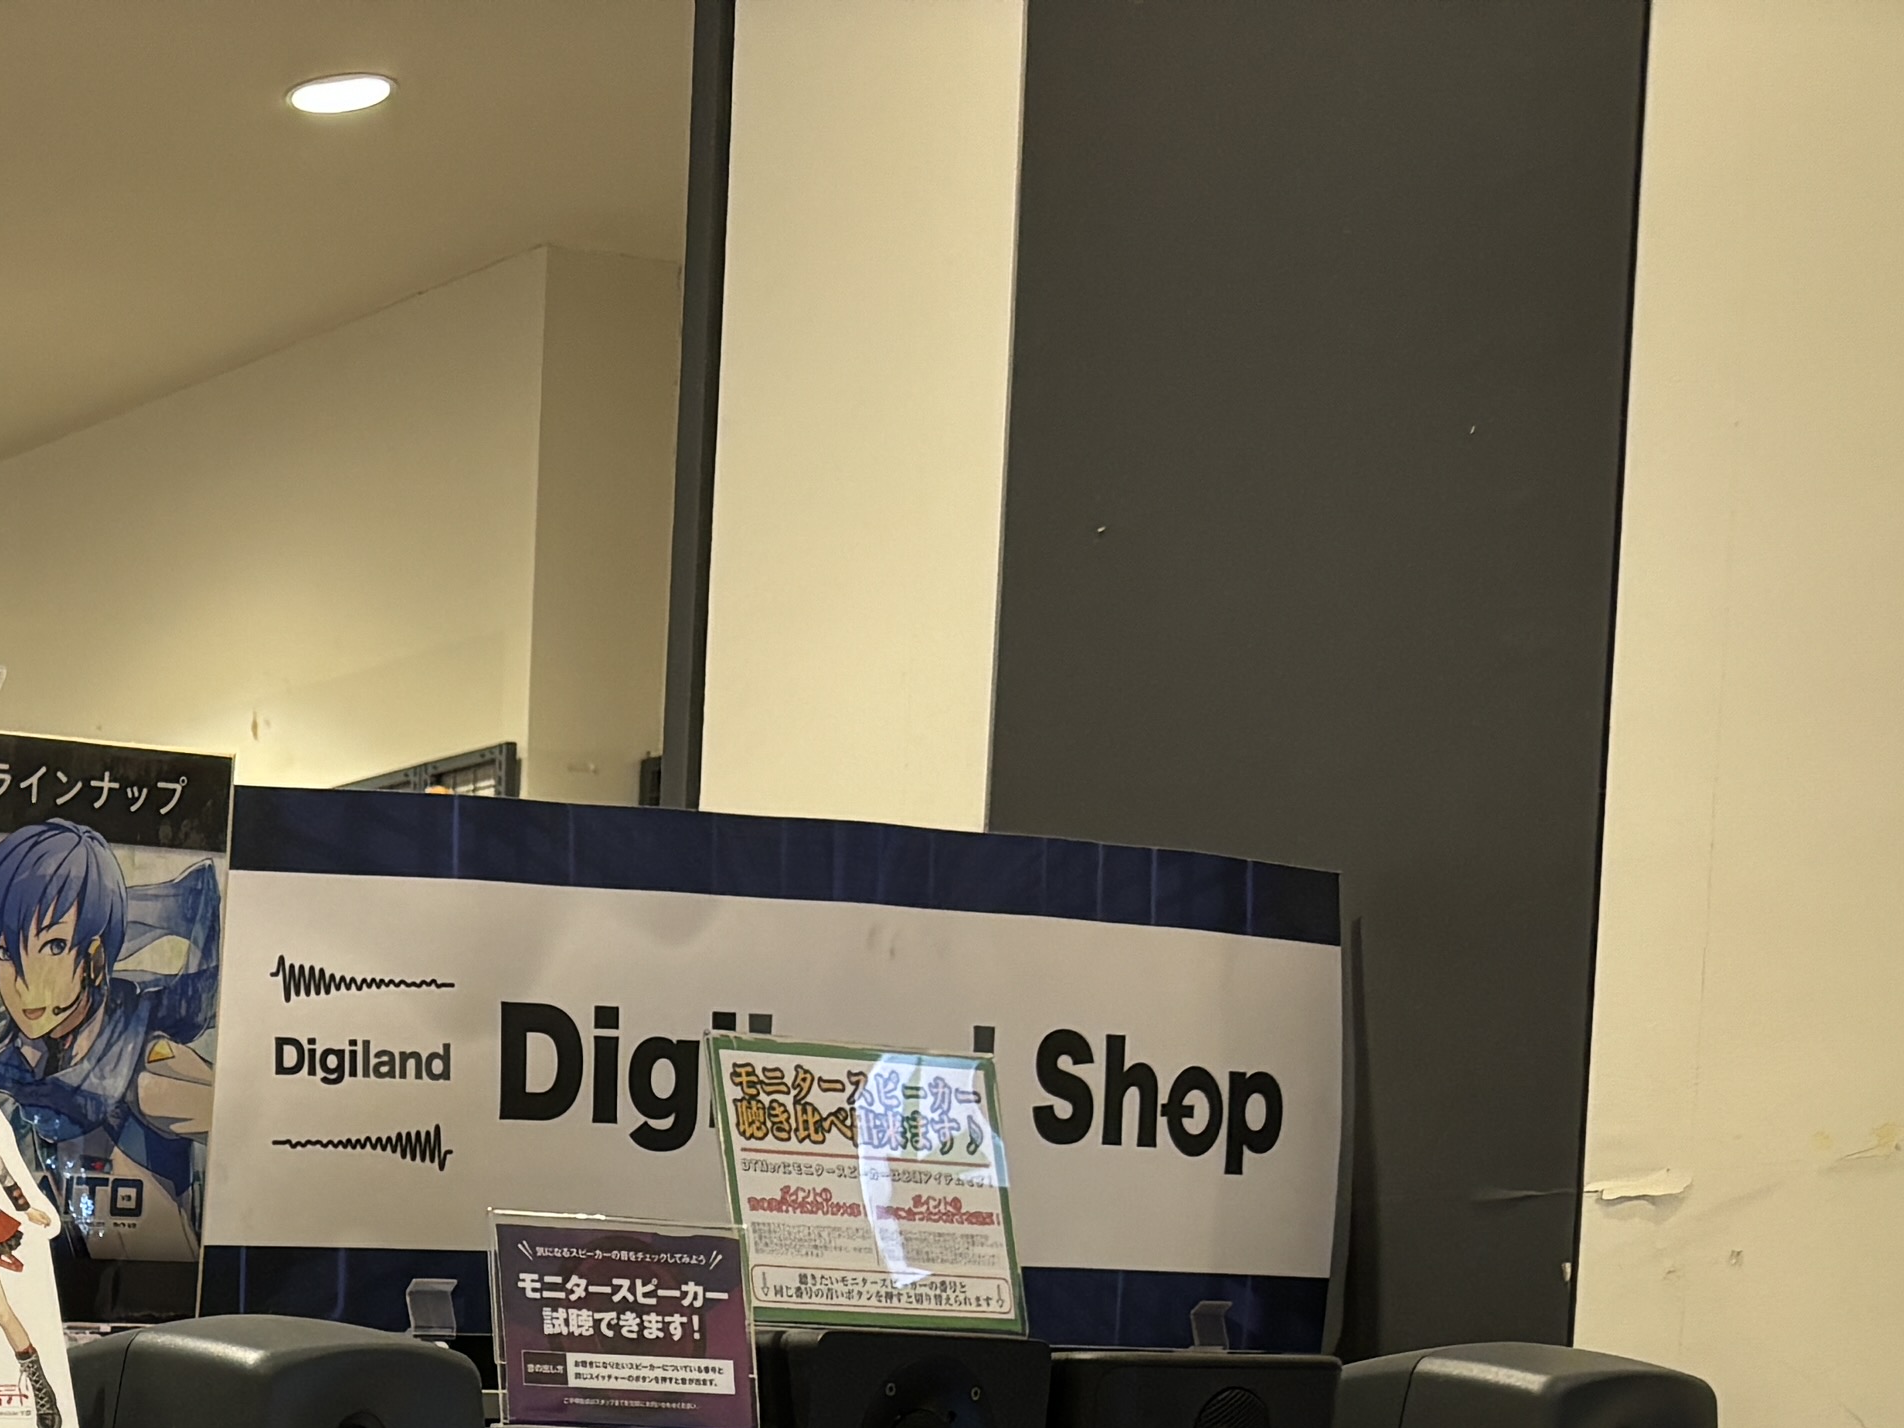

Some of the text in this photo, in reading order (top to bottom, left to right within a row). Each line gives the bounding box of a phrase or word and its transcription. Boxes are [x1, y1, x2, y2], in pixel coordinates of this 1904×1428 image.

[273, 1036, 453, 1084] Digiland
[1034, 1027, 1285, 1175] Shop
[517, 1272, 729, 1306] モニタースピーカー
[542, 1307, 702, 1341] 試聴できます！
